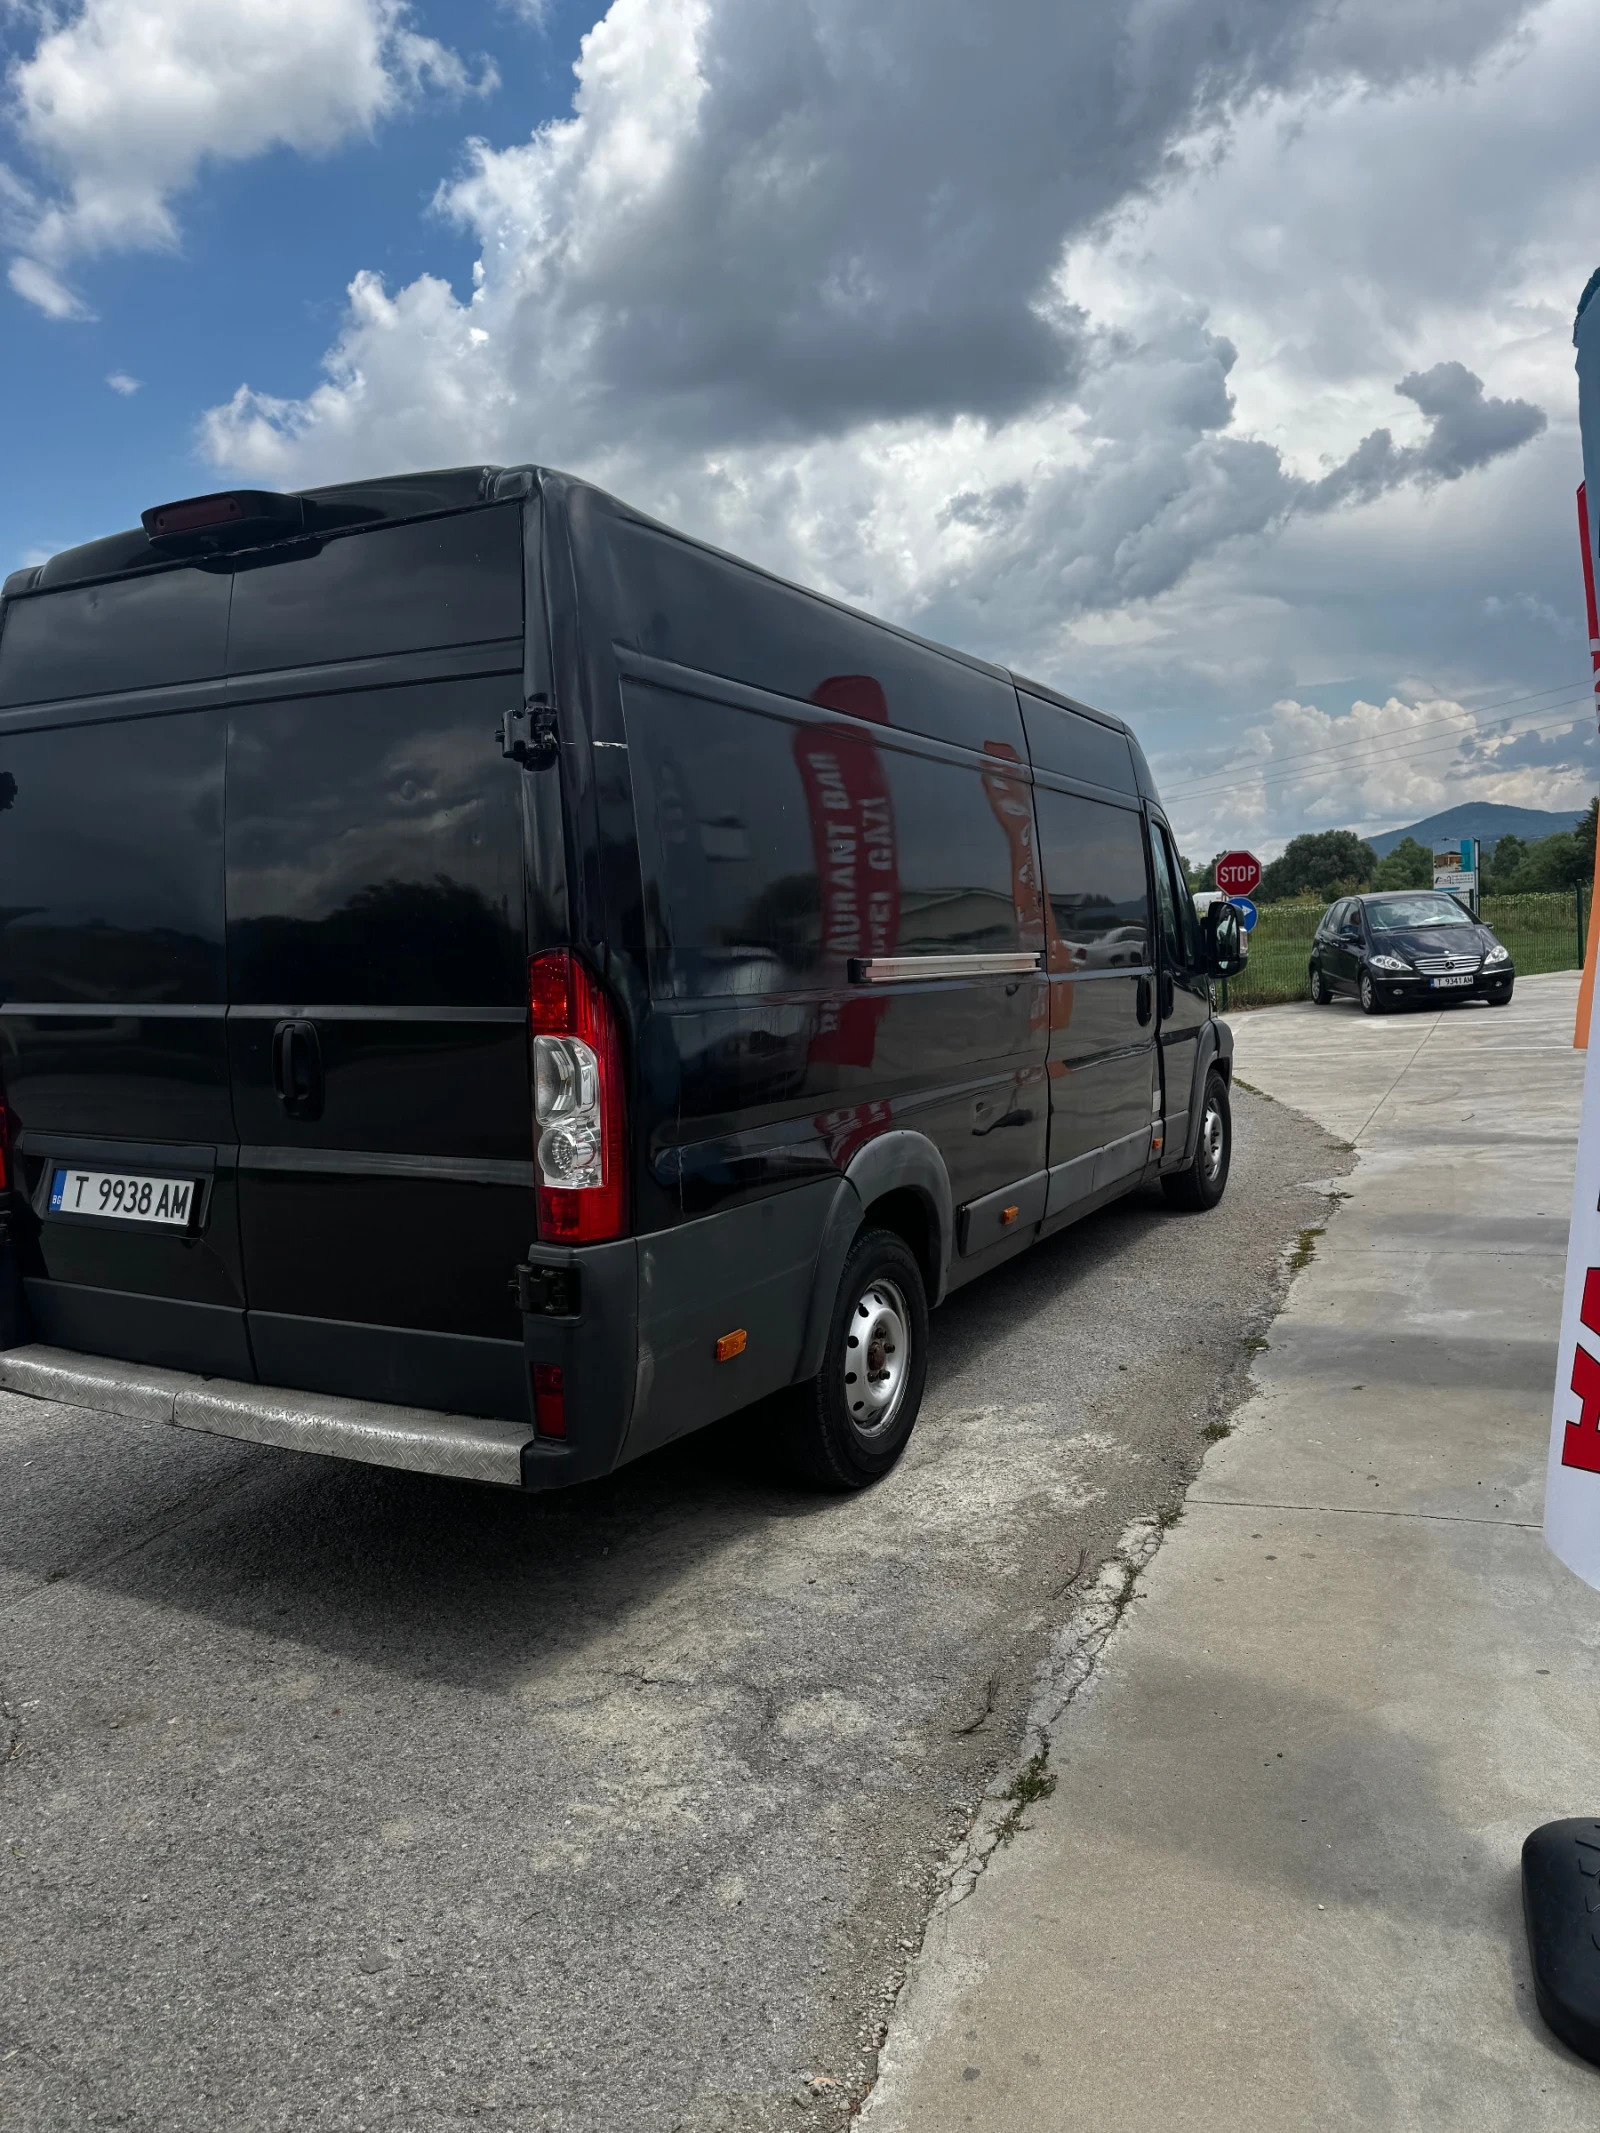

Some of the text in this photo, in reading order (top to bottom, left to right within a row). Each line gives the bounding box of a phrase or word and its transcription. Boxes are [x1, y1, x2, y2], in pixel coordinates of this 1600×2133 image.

[1220, 865, 1257, 883] STOP
[1437, 978, 1442, 986] T
[1445, 976, 1462, 985] 9341
[1463, 976, 1473, 984] AM
[52, 1194, 61, 1205] BG
[75, 1175, 190, 1219] T 9938 AM
